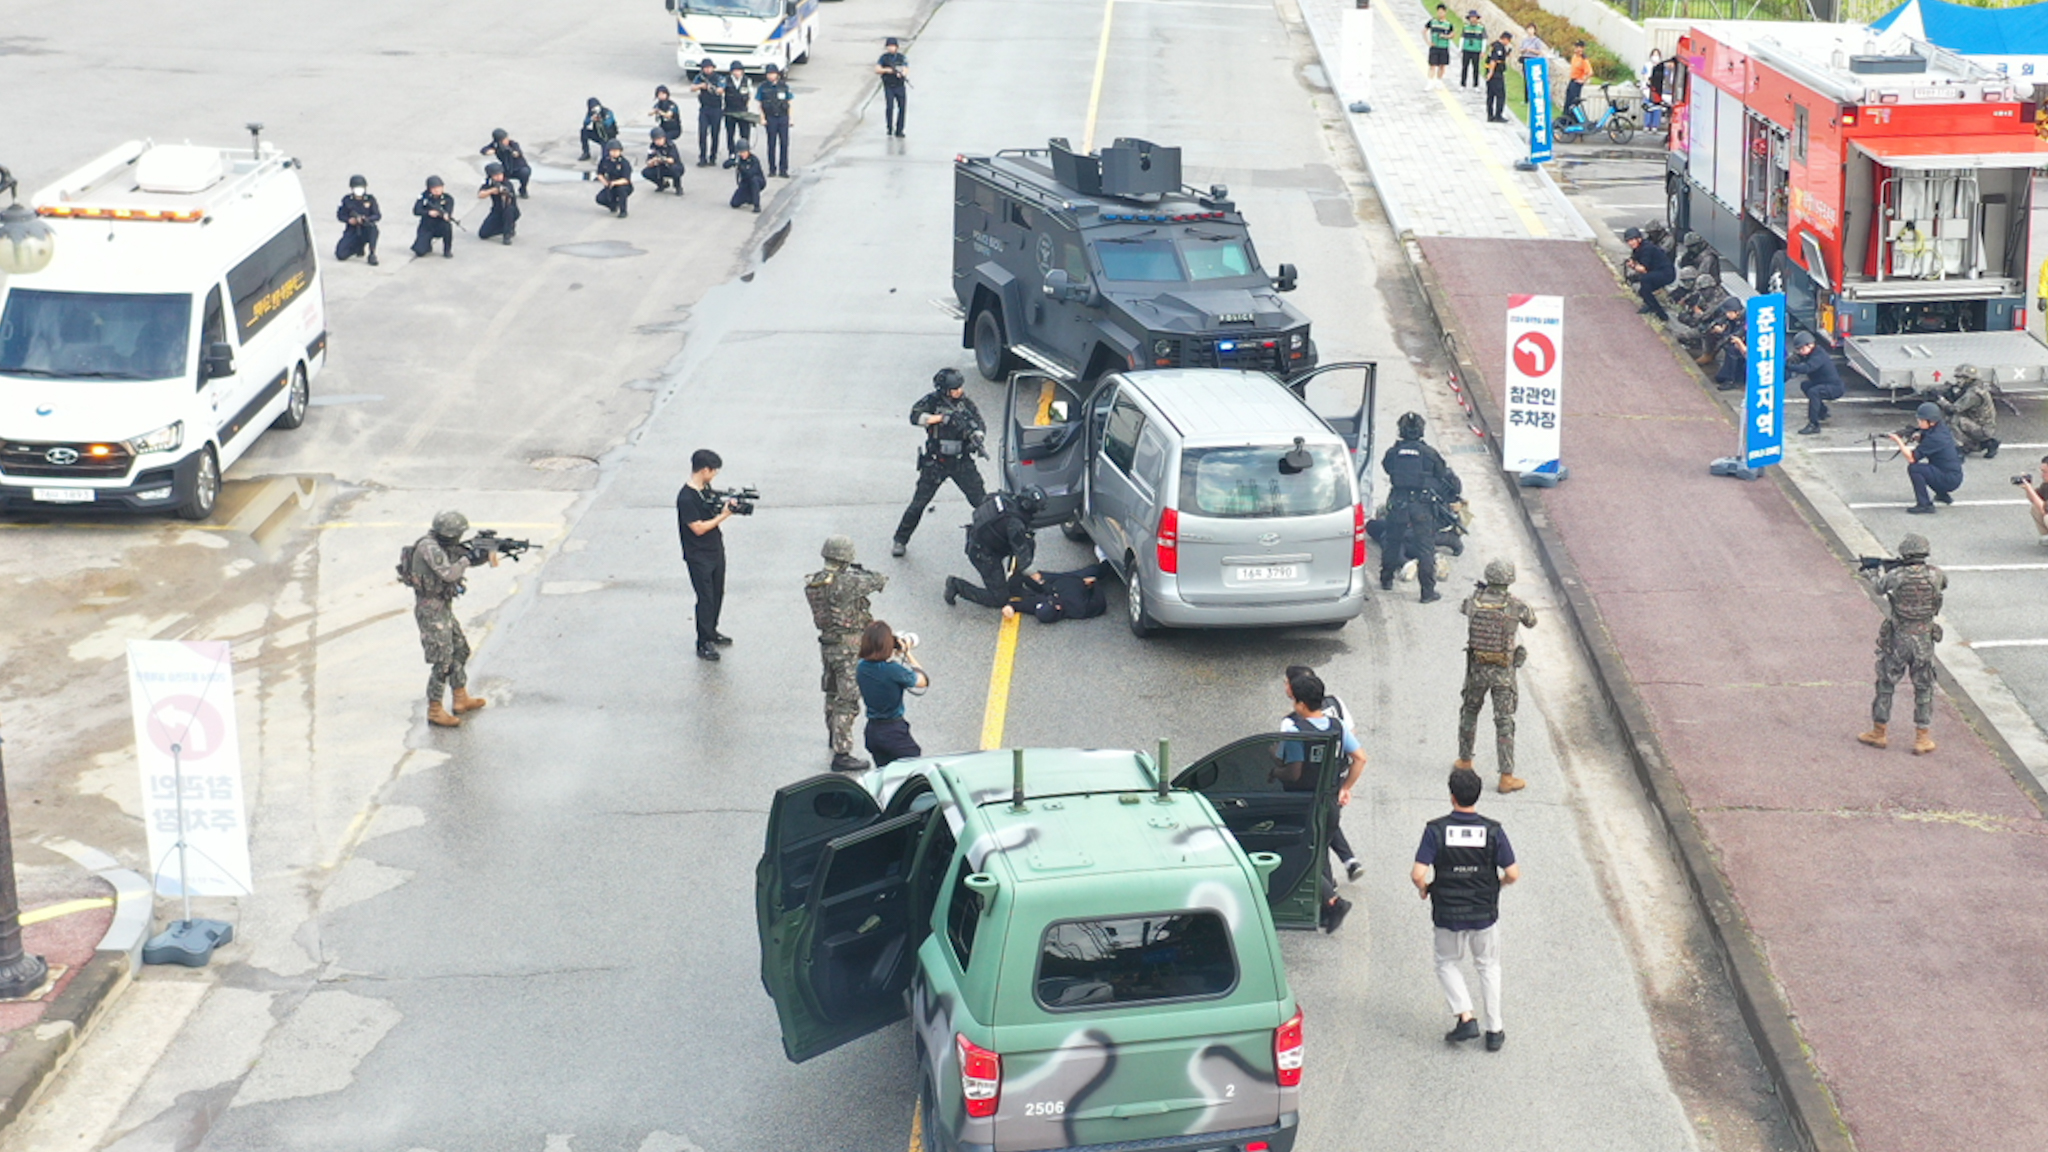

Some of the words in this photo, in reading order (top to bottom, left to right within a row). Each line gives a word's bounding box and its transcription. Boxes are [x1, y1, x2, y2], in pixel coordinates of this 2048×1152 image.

[1756, 306, 1777, 437] 준위험지역
[1509, 386, 1555, 406] 참관인
[1509, 409, 1556, 429] 주차장
[1267, 566, 1292, 578] 3790
[1225, 1084, 1235, 1097] 2
[1025, 1101, 1065, 1117] 2506
